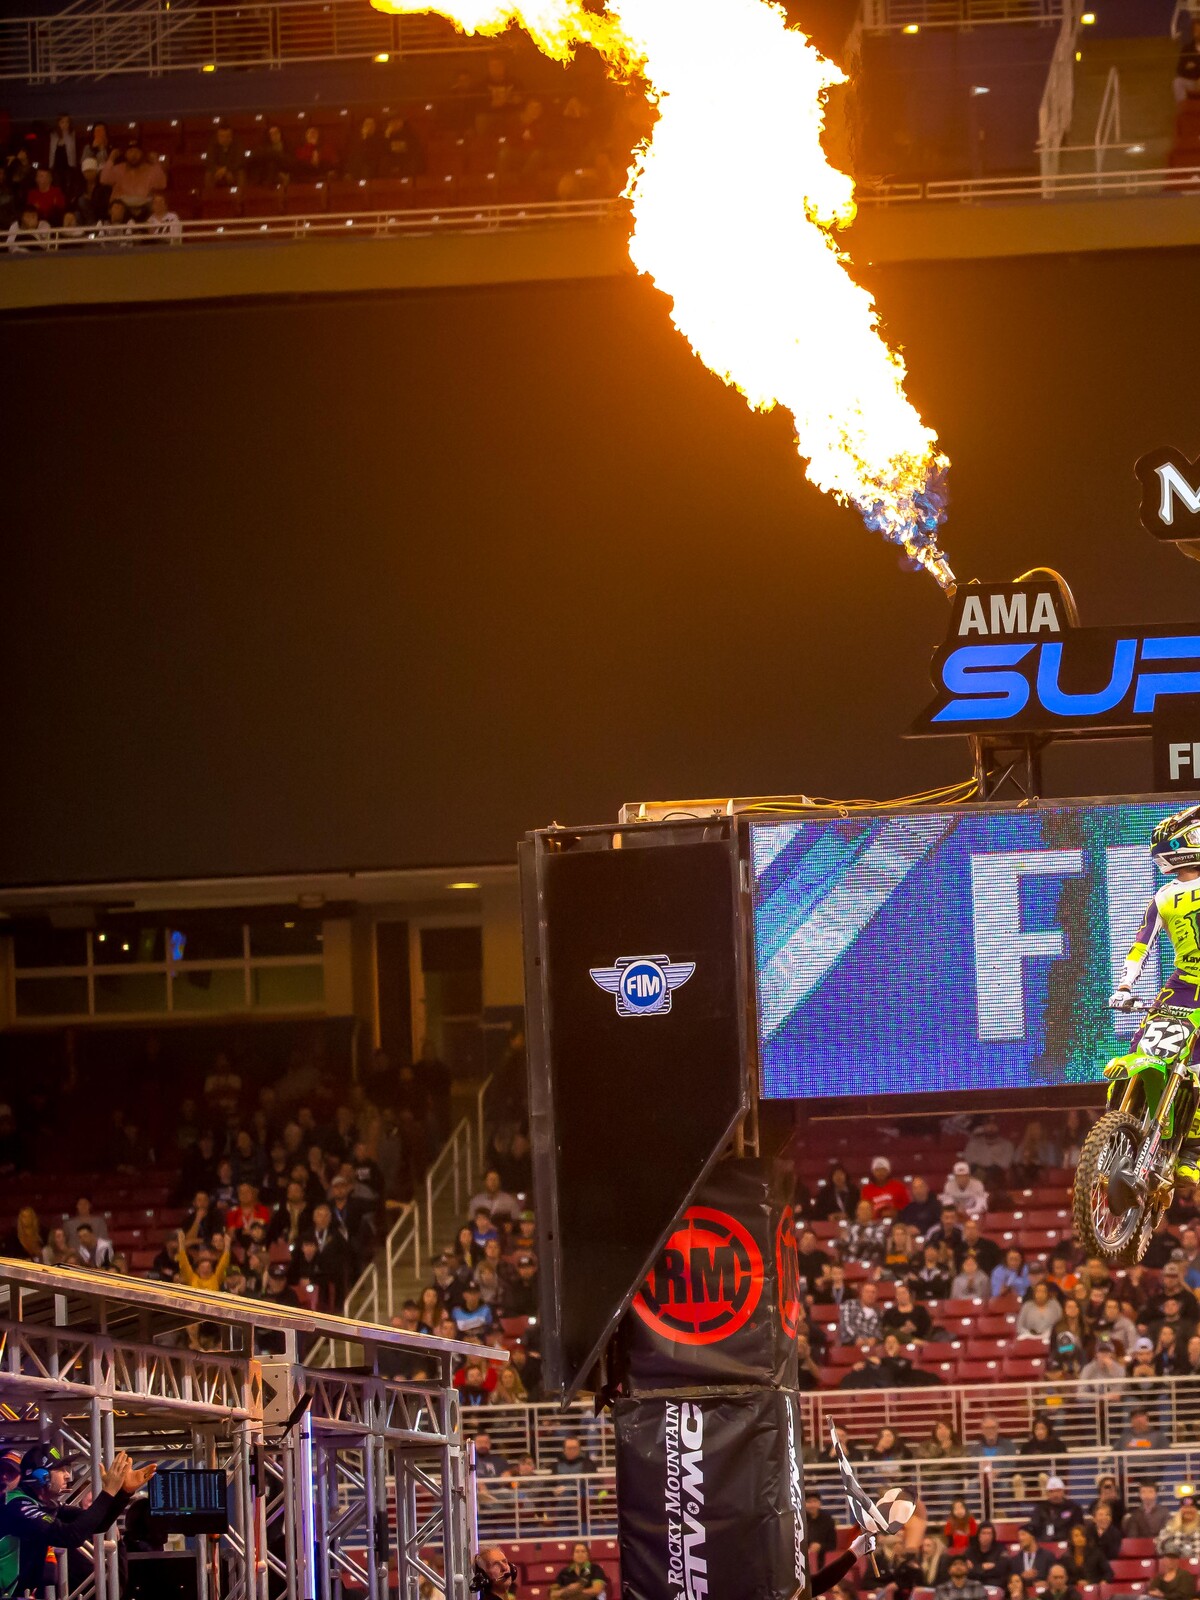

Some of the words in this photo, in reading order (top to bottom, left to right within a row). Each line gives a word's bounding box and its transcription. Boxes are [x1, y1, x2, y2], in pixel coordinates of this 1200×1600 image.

[957, 592, 1061, 636] AMA
[627, 974, 660, 997] FIM
[1140, 1021, 1190, 1053] 52
[1133, 1136, 1151, 1175] DUNLOP
[654, 1247, 737, 1304] RM
[665, 1401, 681, 1517] MOUNTAIN
[668, 1517, 685, 1588] ROCKY
